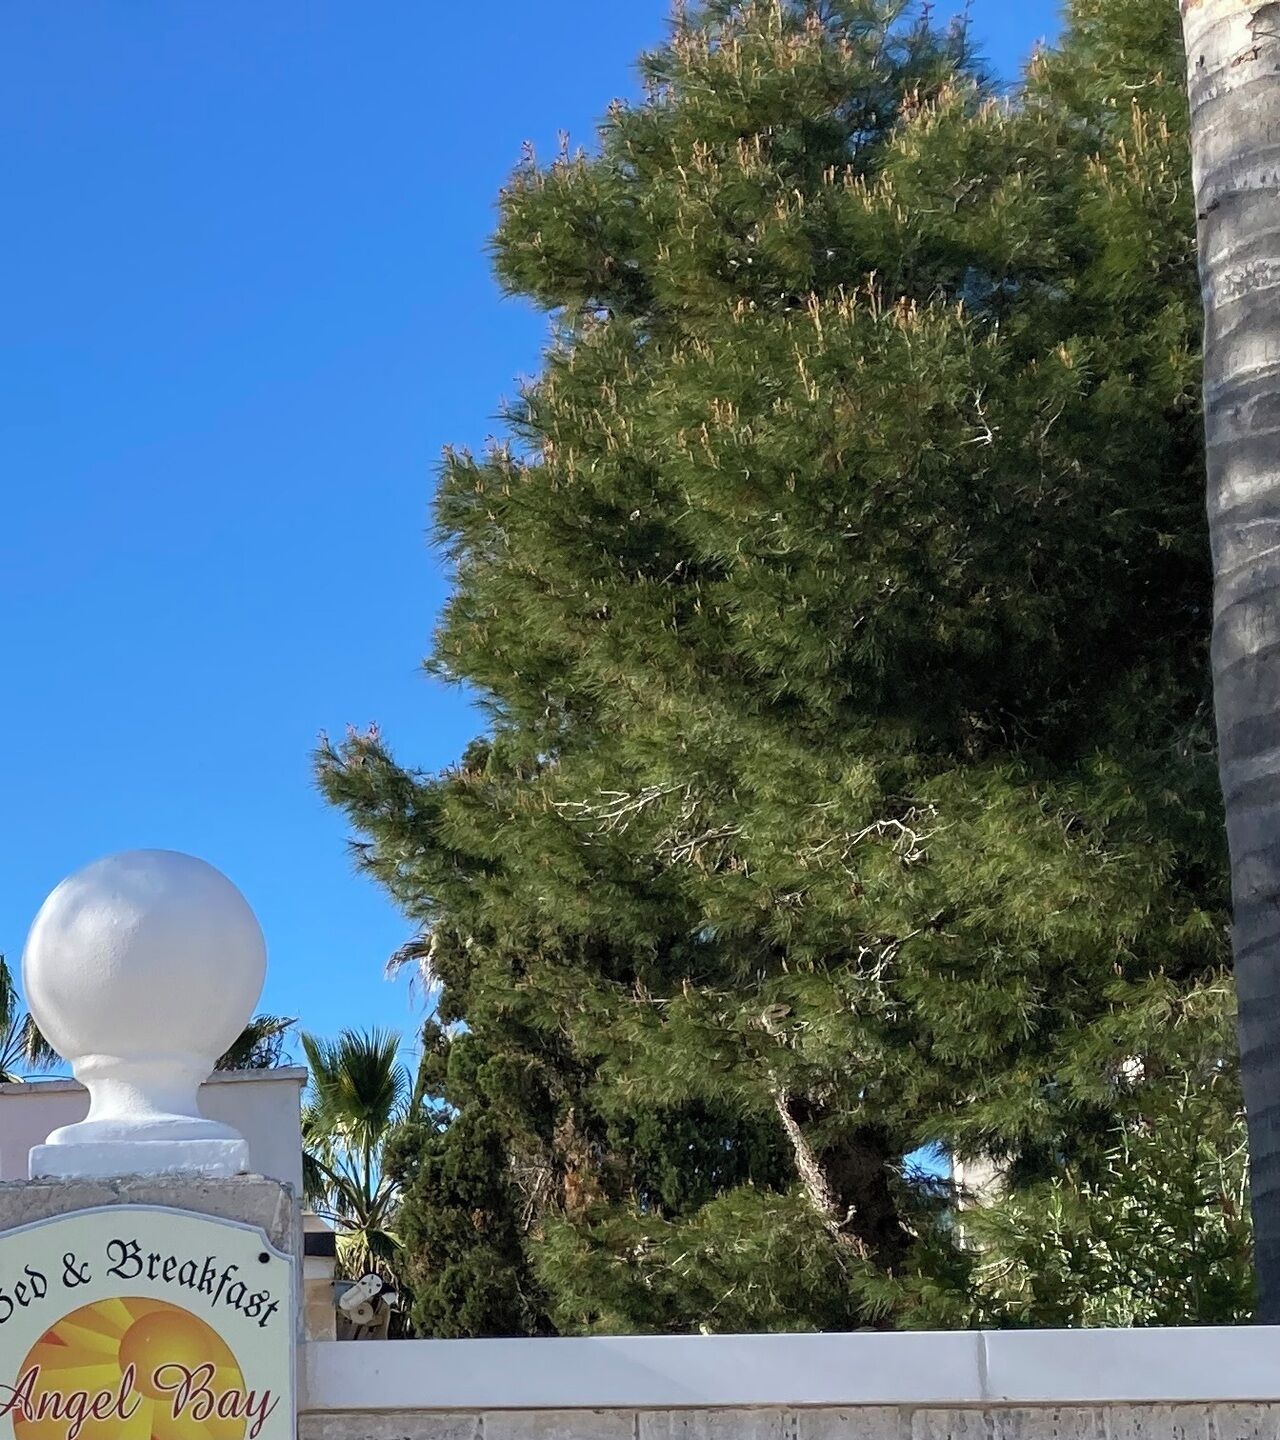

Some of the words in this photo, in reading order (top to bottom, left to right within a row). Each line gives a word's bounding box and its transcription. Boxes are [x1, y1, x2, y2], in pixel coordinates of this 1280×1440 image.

[62, 1252, 91, 1287] &
[107, 1238, 280, 1328] Breakfast
[153, 1361, 280, 1439] Bay
